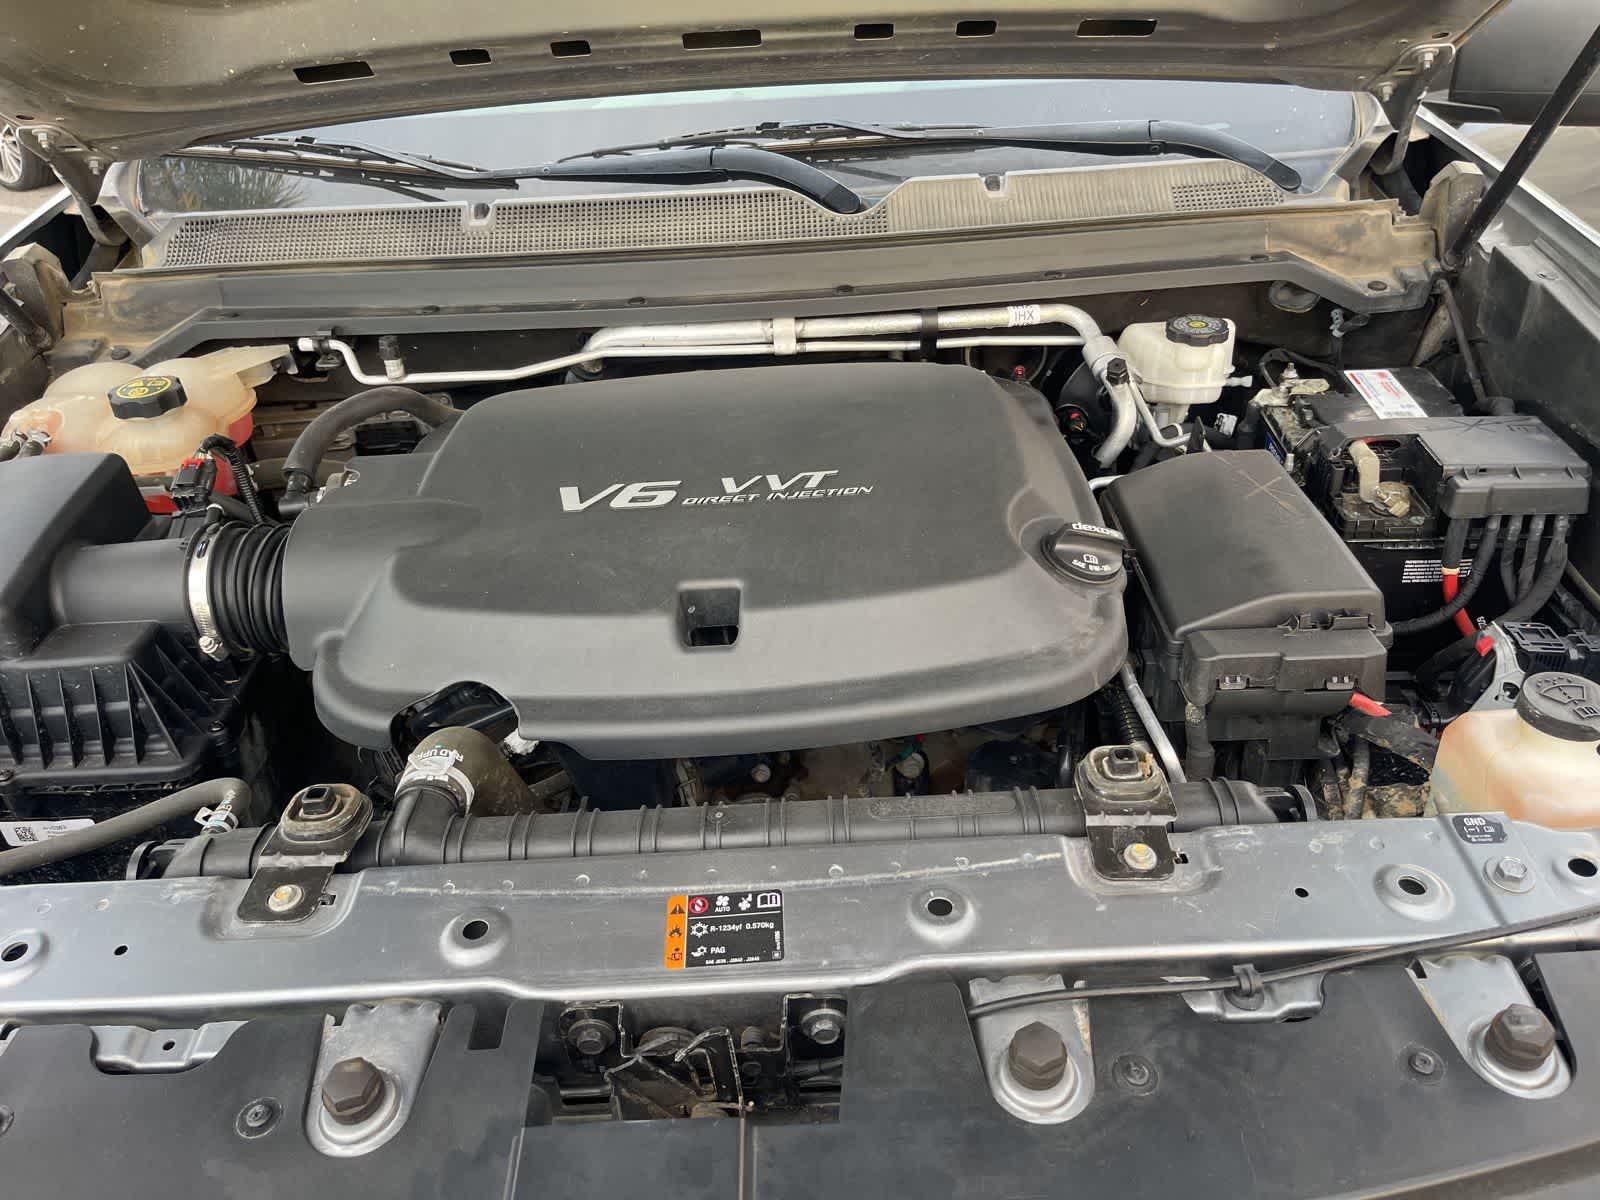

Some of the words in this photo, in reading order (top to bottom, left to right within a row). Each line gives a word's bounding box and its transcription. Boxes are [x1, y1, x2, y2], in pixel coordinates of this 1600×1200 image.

[721, 470, 839, 493] VVT
[559, 480, 682, 511] V6
[682, 493, 760, 504] DIRECT
[766, 486, 873, 501] INJECTION
[1463, 817, 1486, 826] GND
[709, 924, 743, 932] R-1234yf
[710, 946, 726, 954] PAG
